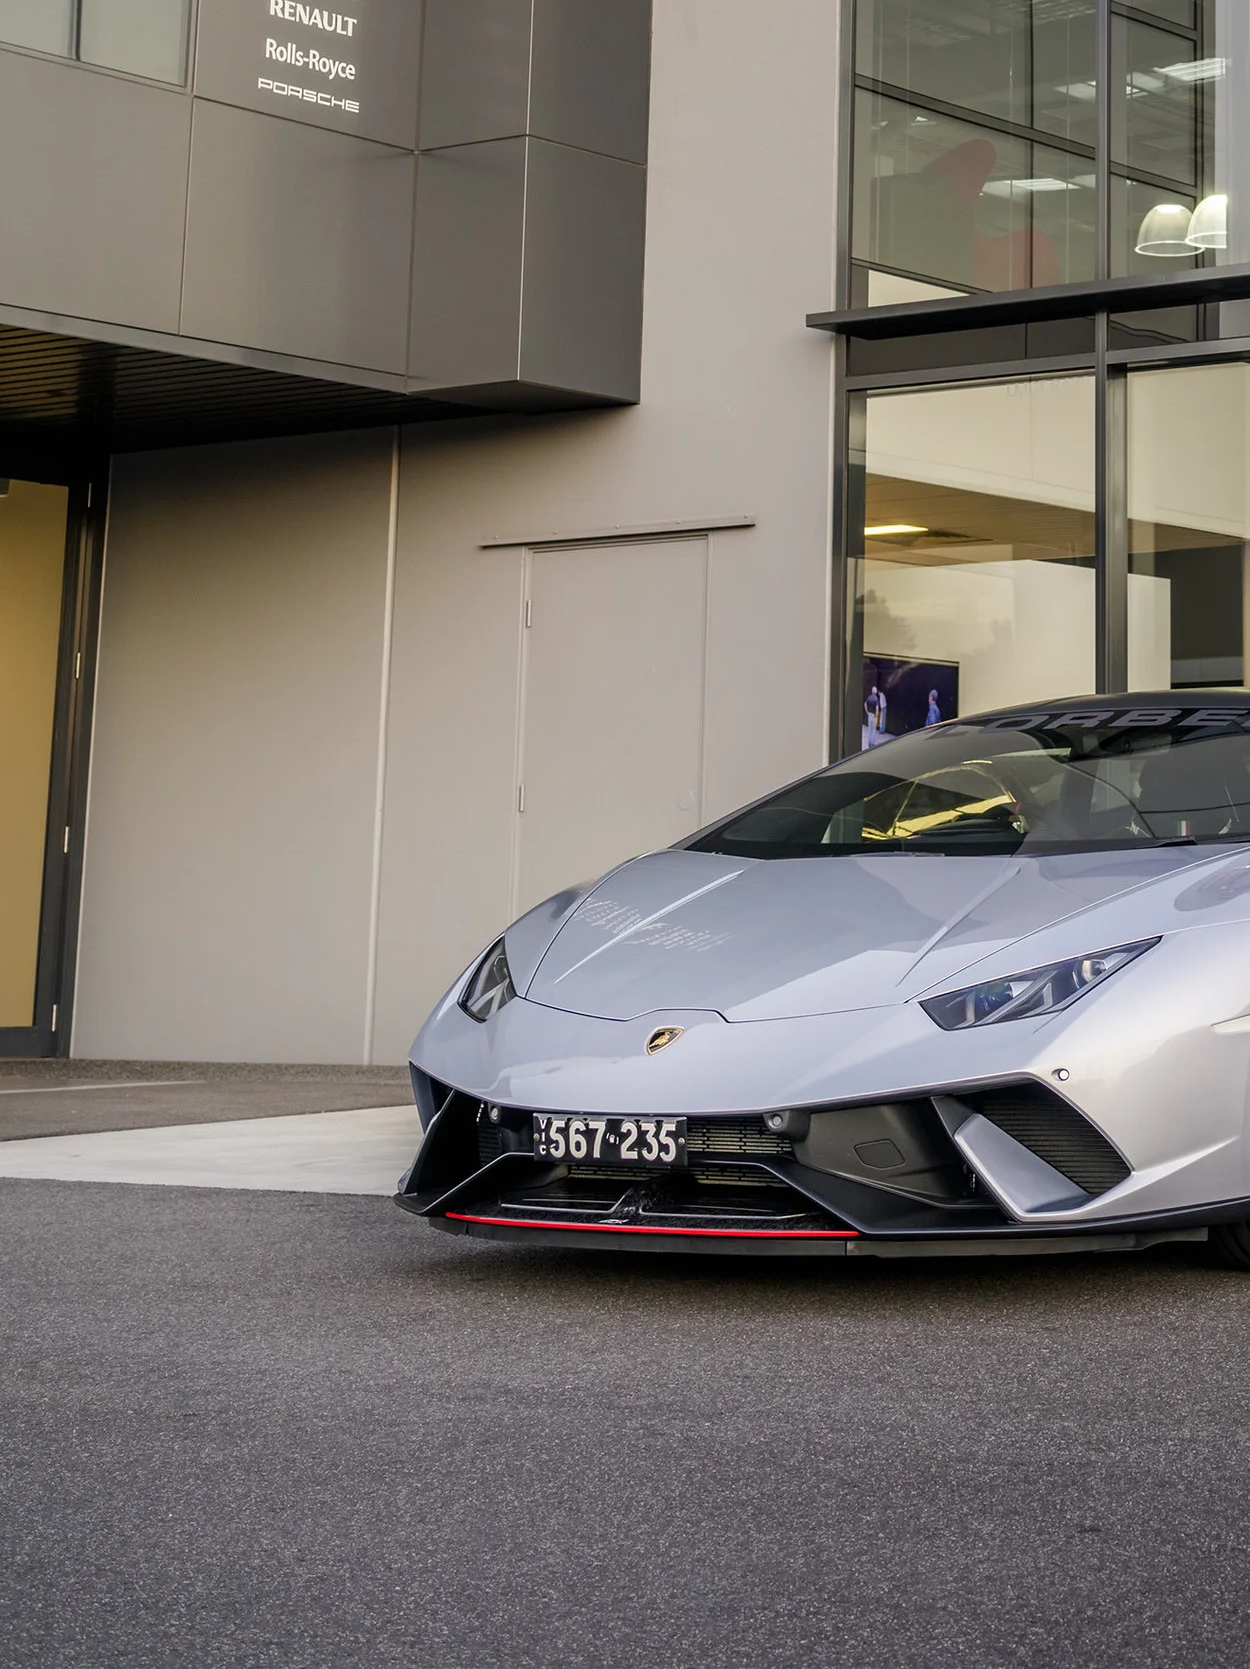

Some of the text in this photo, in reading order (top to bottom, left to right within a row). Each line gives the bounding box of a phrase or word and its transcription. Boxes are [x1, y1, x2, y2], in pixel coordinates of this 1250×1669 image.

[265, 38, 356, 80] Rolls-Royce
[258, 77, 360, 114] PORSCHE
[538, 1119, 547, 1155] VIC
